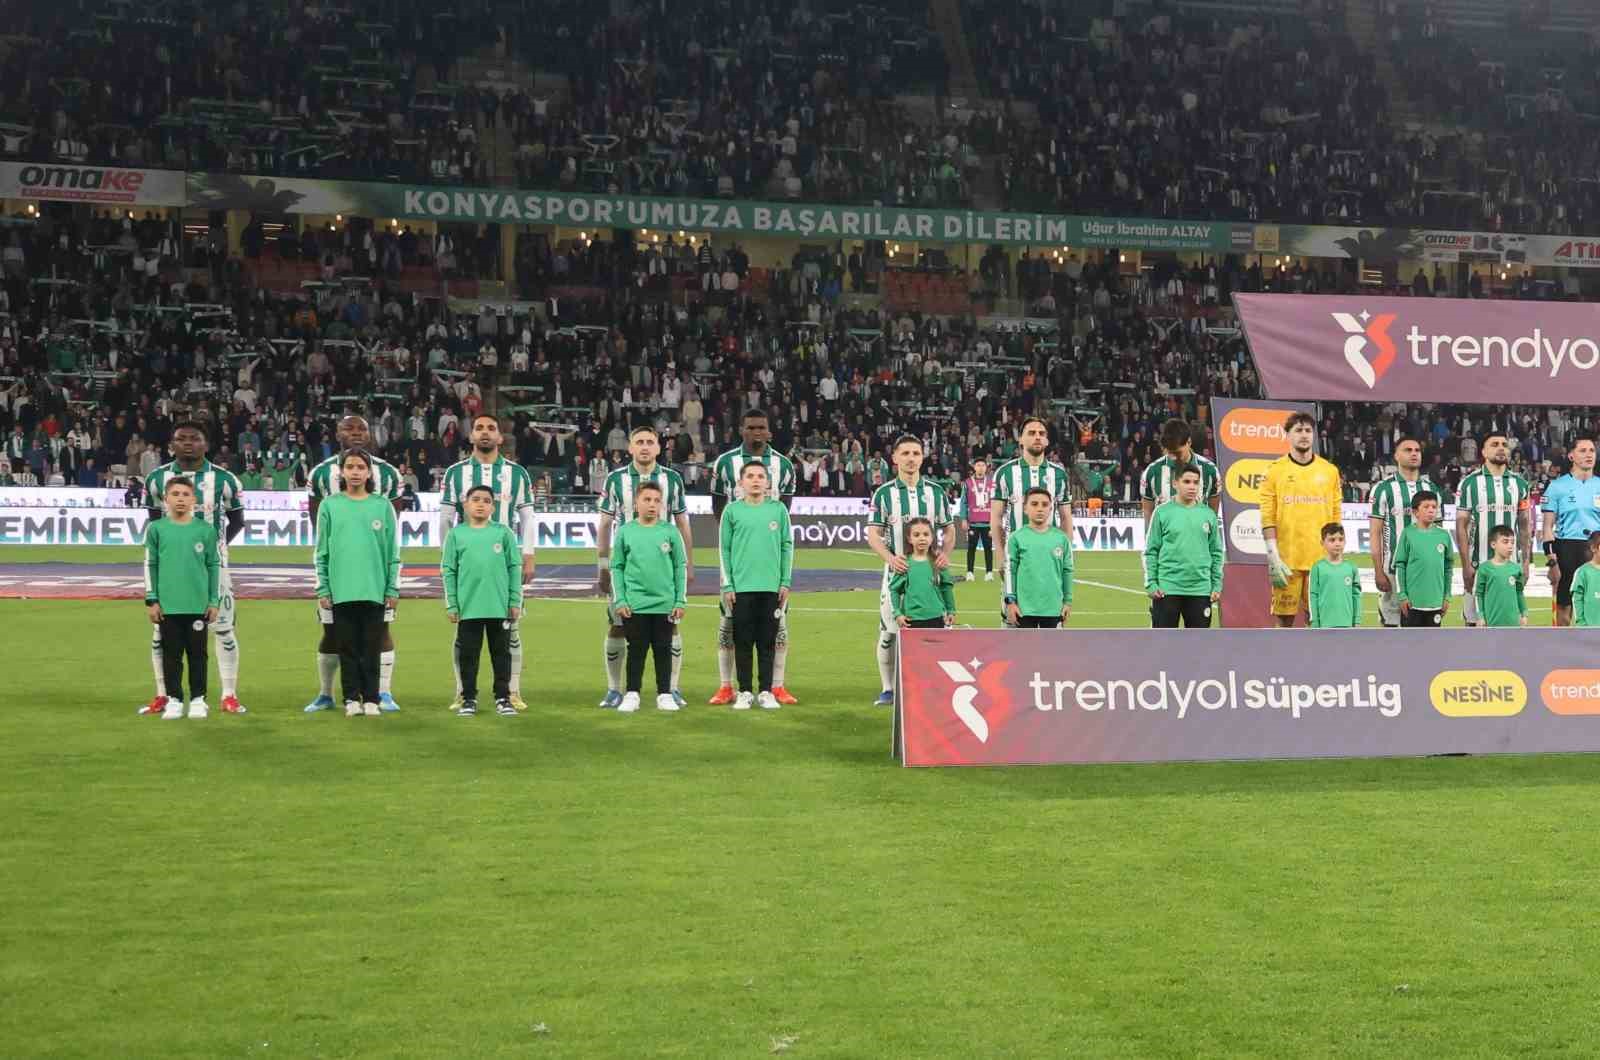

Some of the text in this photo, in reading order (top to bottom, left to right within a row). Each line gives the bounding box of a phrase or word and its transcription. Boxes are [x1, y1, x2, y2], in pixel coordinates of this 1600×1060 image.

[753, 206, 934, 237] BAŞARILAR
[943, 211, 1067, 242] DİLERİM
[1082, 220, 1211, 239] Uğur İbrahim ALTAY
[1406, 325, 1600, 378] trendyo
[1029, 670, 1237, 719] trendyol
